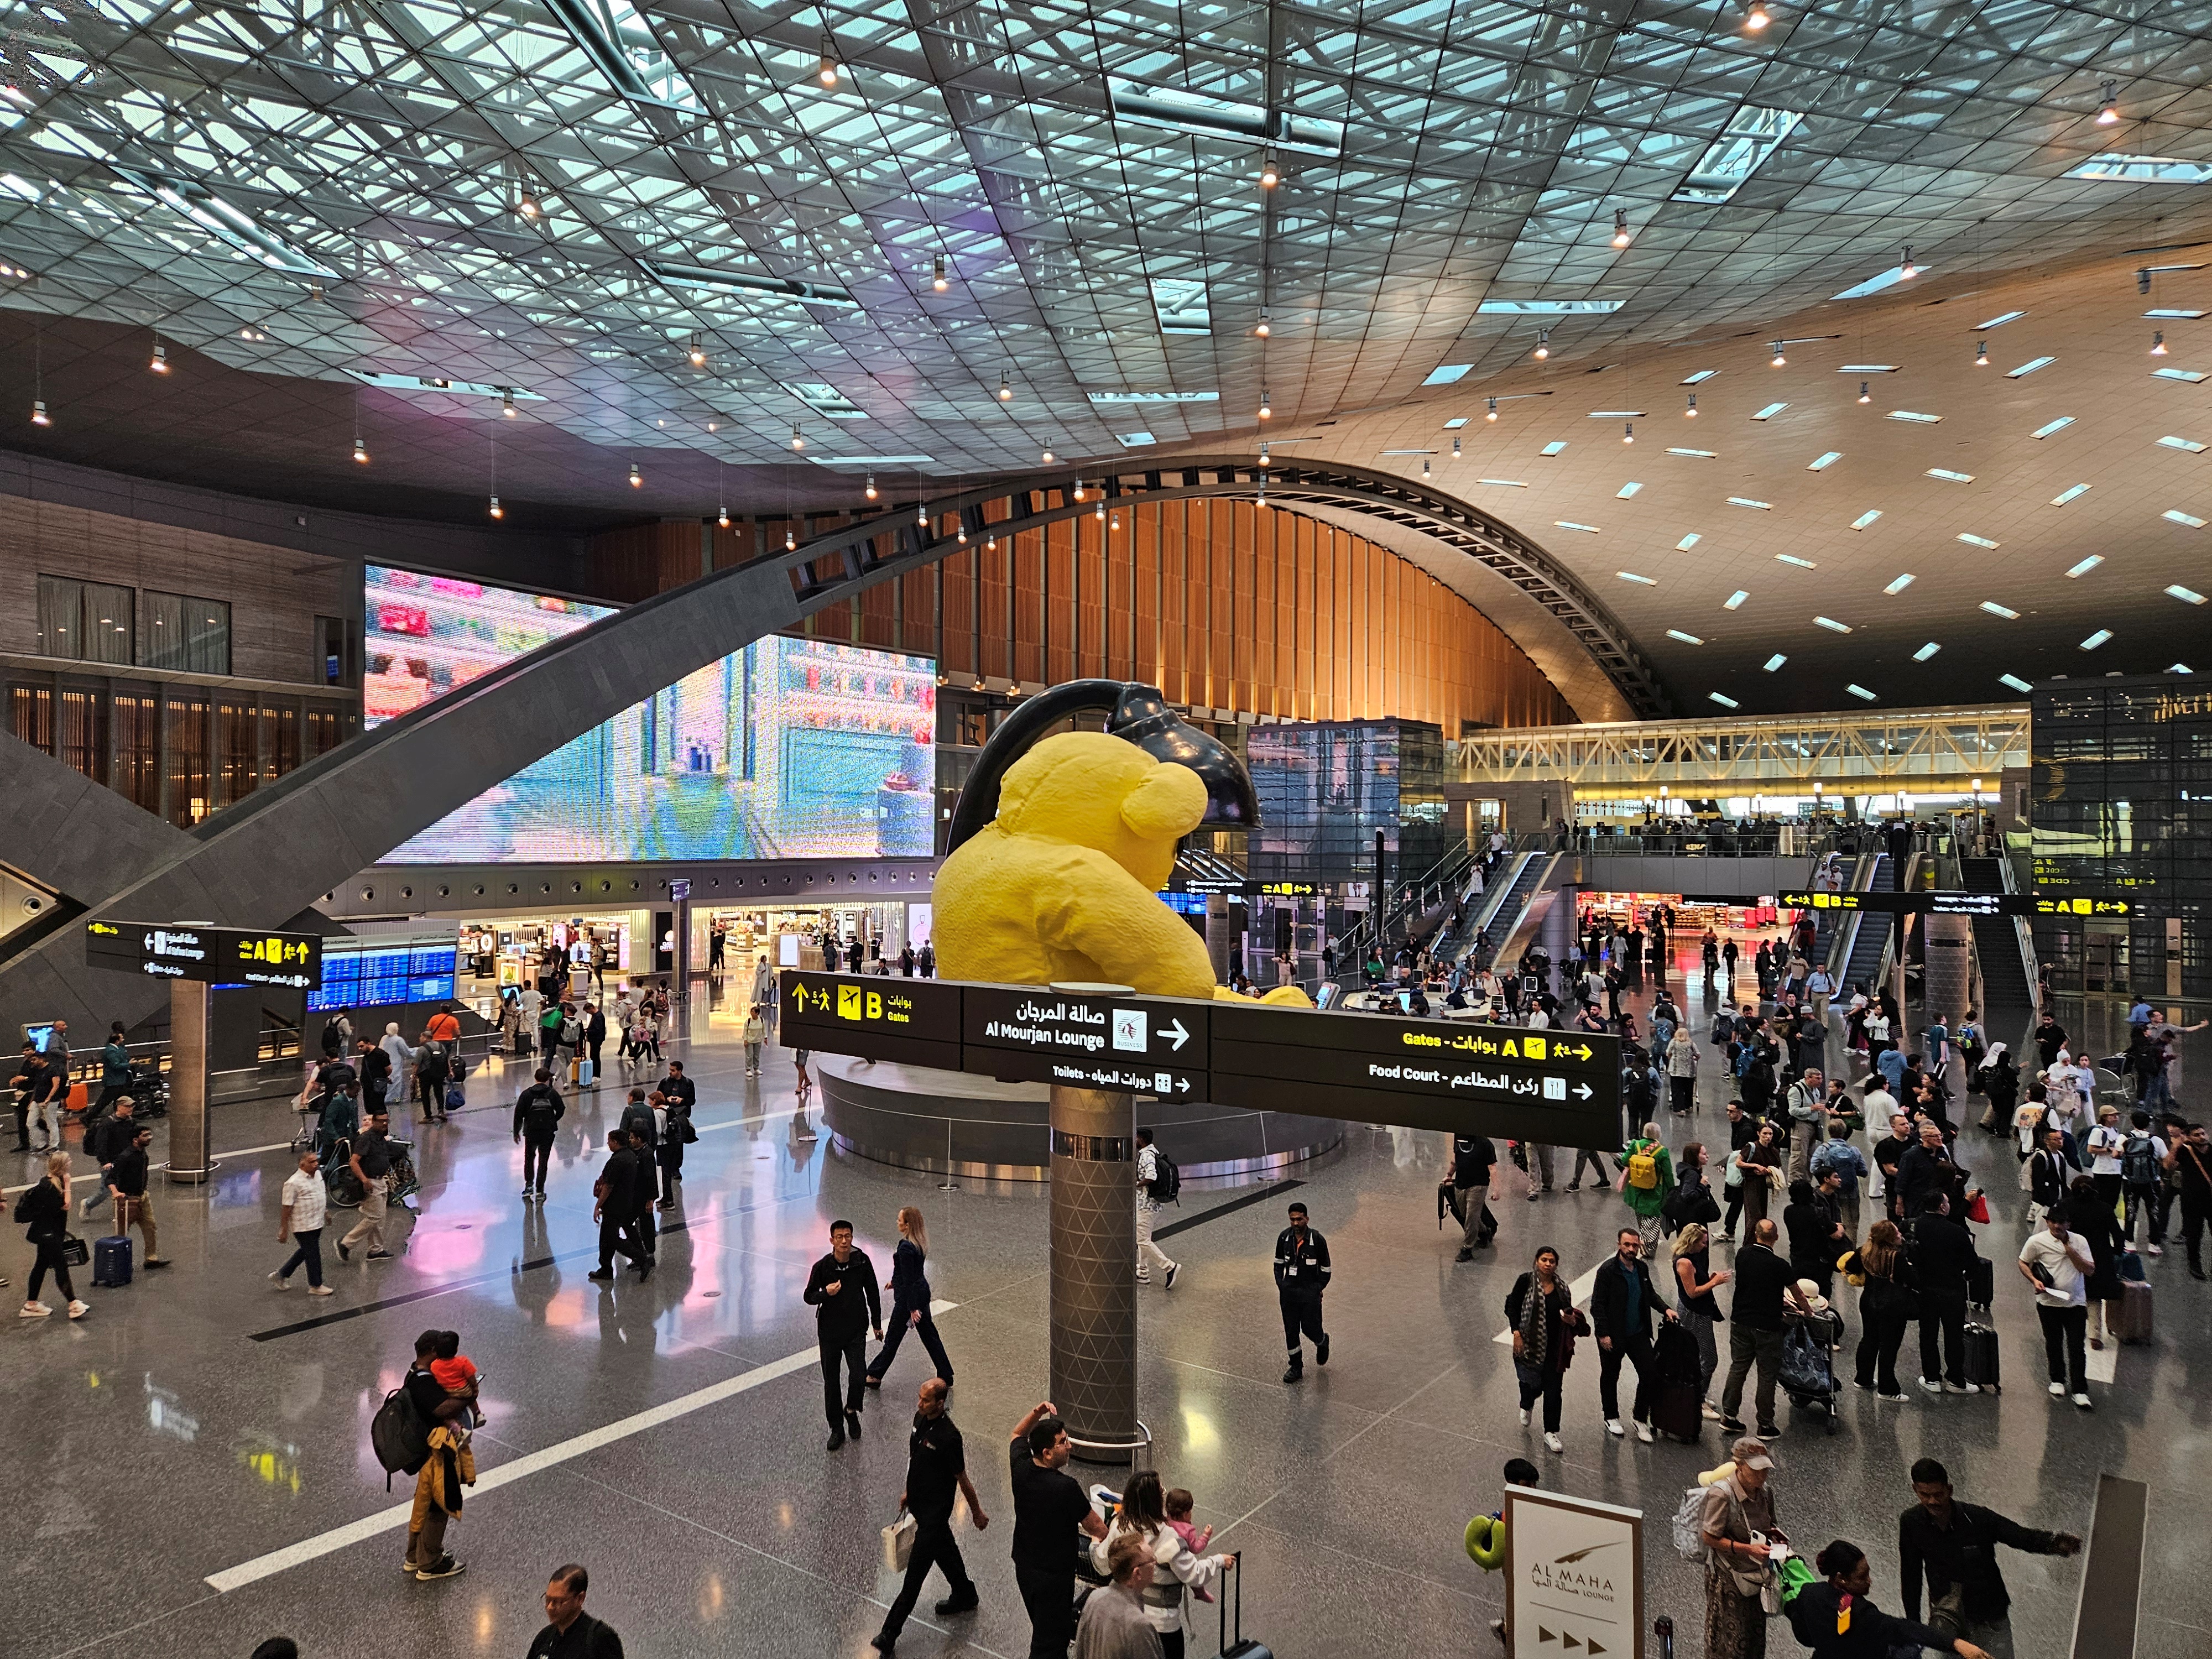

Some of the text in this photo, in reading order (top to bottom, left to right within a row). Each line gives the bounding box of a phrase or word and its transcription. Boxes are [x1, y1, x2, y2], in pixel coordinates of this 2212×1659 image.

[1272, 884, 1281, 894] A
[1830, 895, 1841, 907] B
[2056, 900, 2071, 913] A
[253, 941, 265, 960] A
[866, 992, 882, 1019] B
[888, 995, 911, 1009] بوابات
[888, 1011, 909, 1022] Gates
[1016, 1000, 1105, 1024] صالة المرجان
[985, 1021, 1105, 1051] Al Mourjan Lounge
[1402, 1032, 1442, 1047] Gates
[1452, 1035, 1498, 1055] بوابات
[1501, 1039, 1519, 1058] A
[1052, 1065, 1084, 1079] Toilets
[1092, 1068, 1152, 1089] دورات المياه
[1369, 1064, 1401, 1079] Food
[1402, 1067, 1440, 1083] Court
[1451, 1071, 1539, 1095] ركن المطاعم
[1532, 1562, 1614, 1592] AL MAHA
[1554, 1579, 1579, 1595] صالة
[1583, 1589, 1615, 1603] LOUNGE
